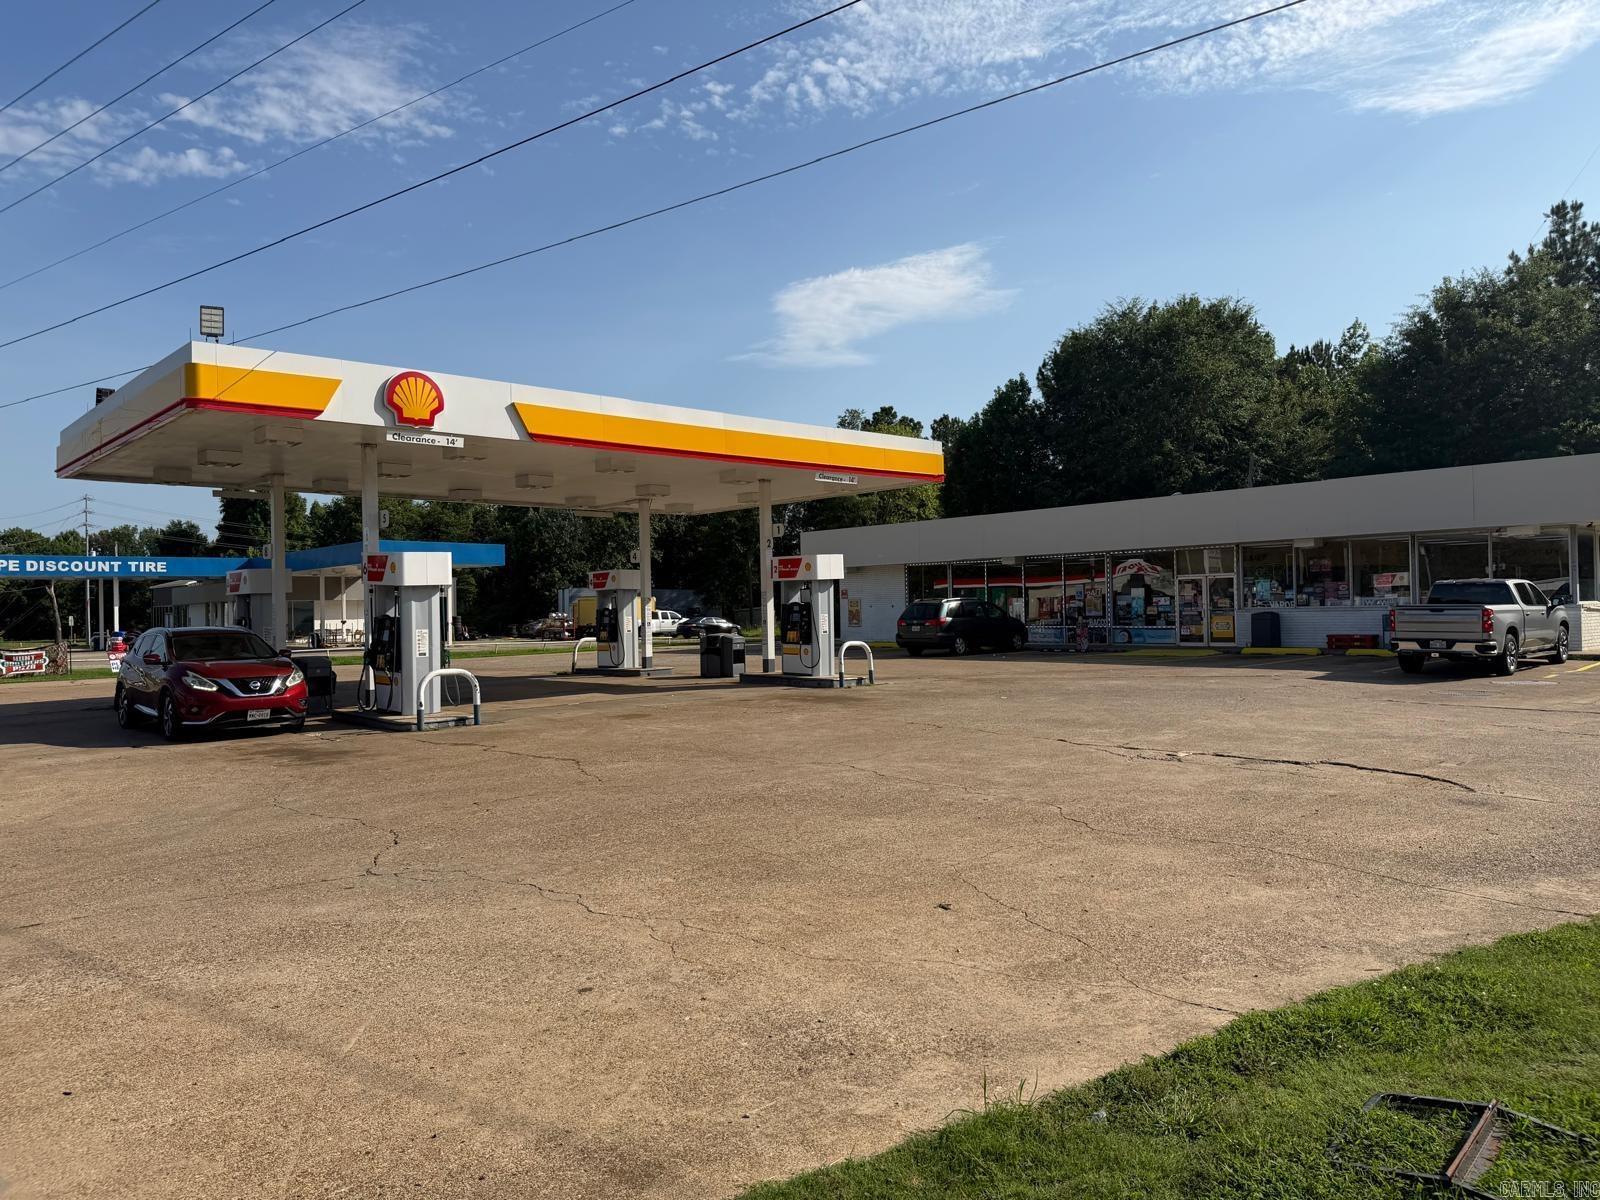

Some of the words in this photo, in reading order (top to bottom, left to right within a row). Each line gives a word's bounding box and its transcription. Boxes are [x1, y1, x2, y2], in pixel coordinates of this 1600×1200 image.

[392, 432, 435, 444] Clearance
[446, 438, 458, 446] 14'
[818, 473, 843, 482] Clearance
[382, 513, 387, 523] 5
[767, 539, 771, 548] 2
[26, 560, 122, 572] DISCOUNT
[128, 561, 167, 573] TIRE
